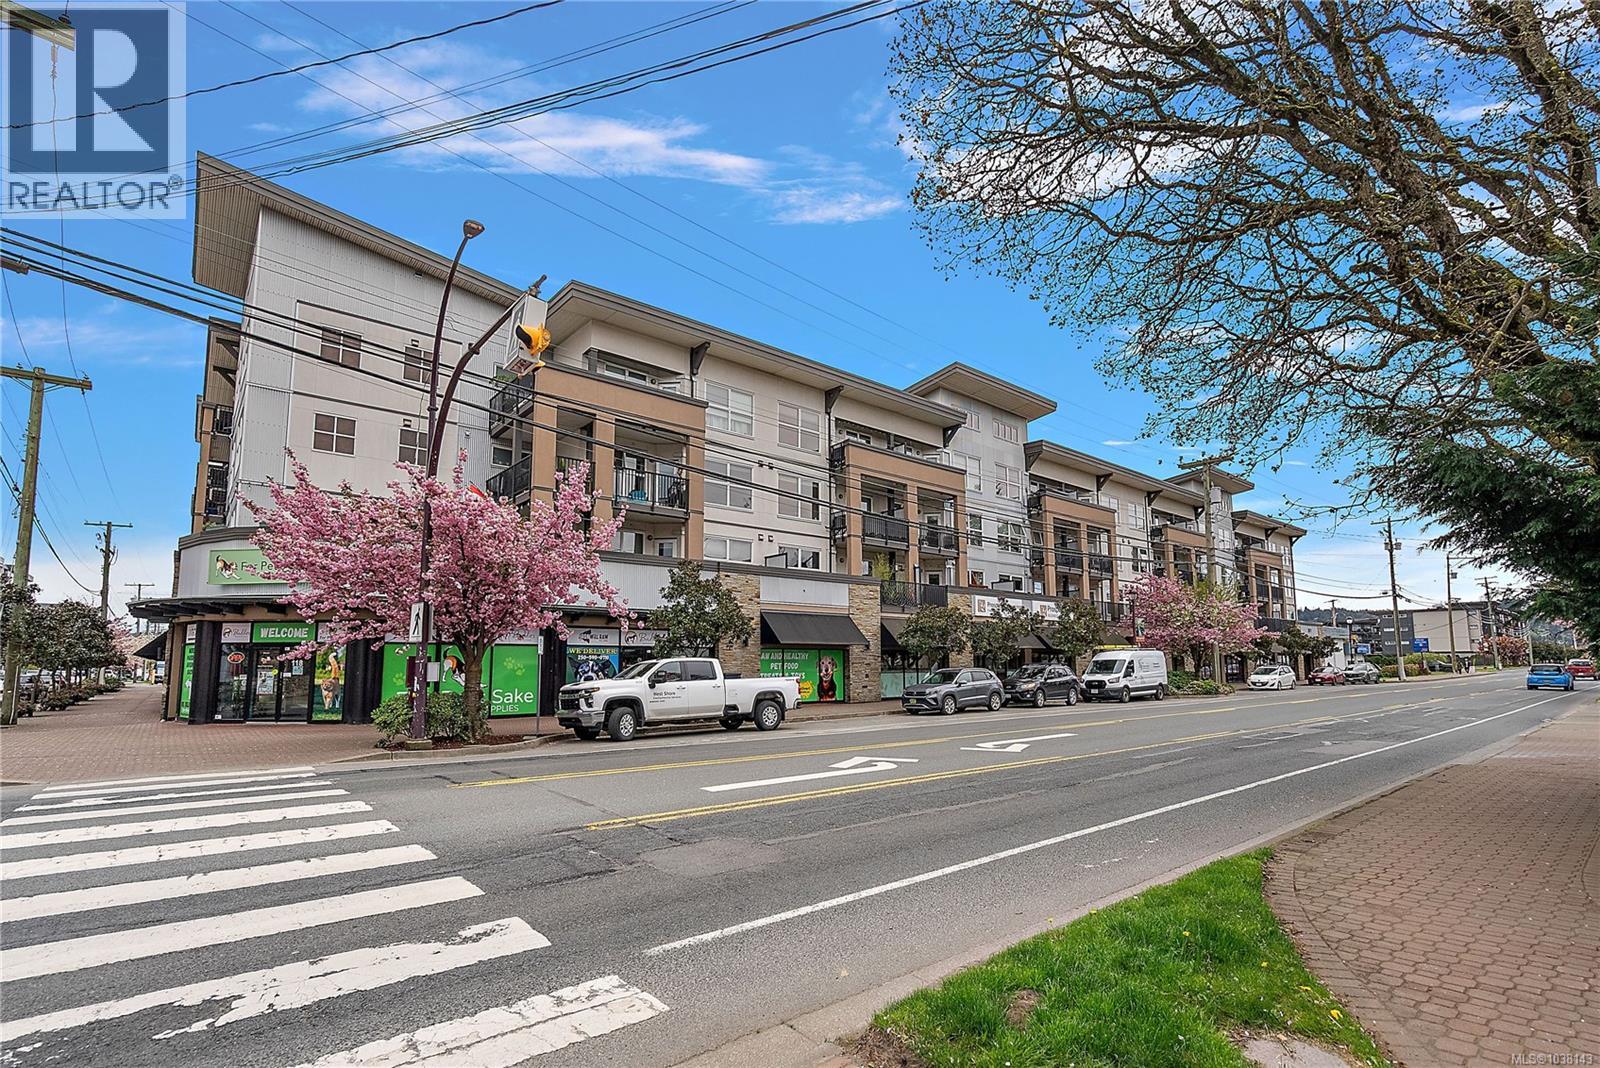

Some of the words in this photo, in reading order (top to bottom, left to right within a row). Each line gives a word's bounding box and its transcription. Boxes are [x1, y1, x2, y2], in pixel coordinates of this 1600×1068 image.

[260, 627, 309, 638] WELCOME
[784, 652, 809, 660] HEALTHY
[770, 662, 782, 670] PET
[784, 662, 799, 670] FOOD
[492, 688, 534, 704] Sake
[491, 704, 520, 712] PPLIES
